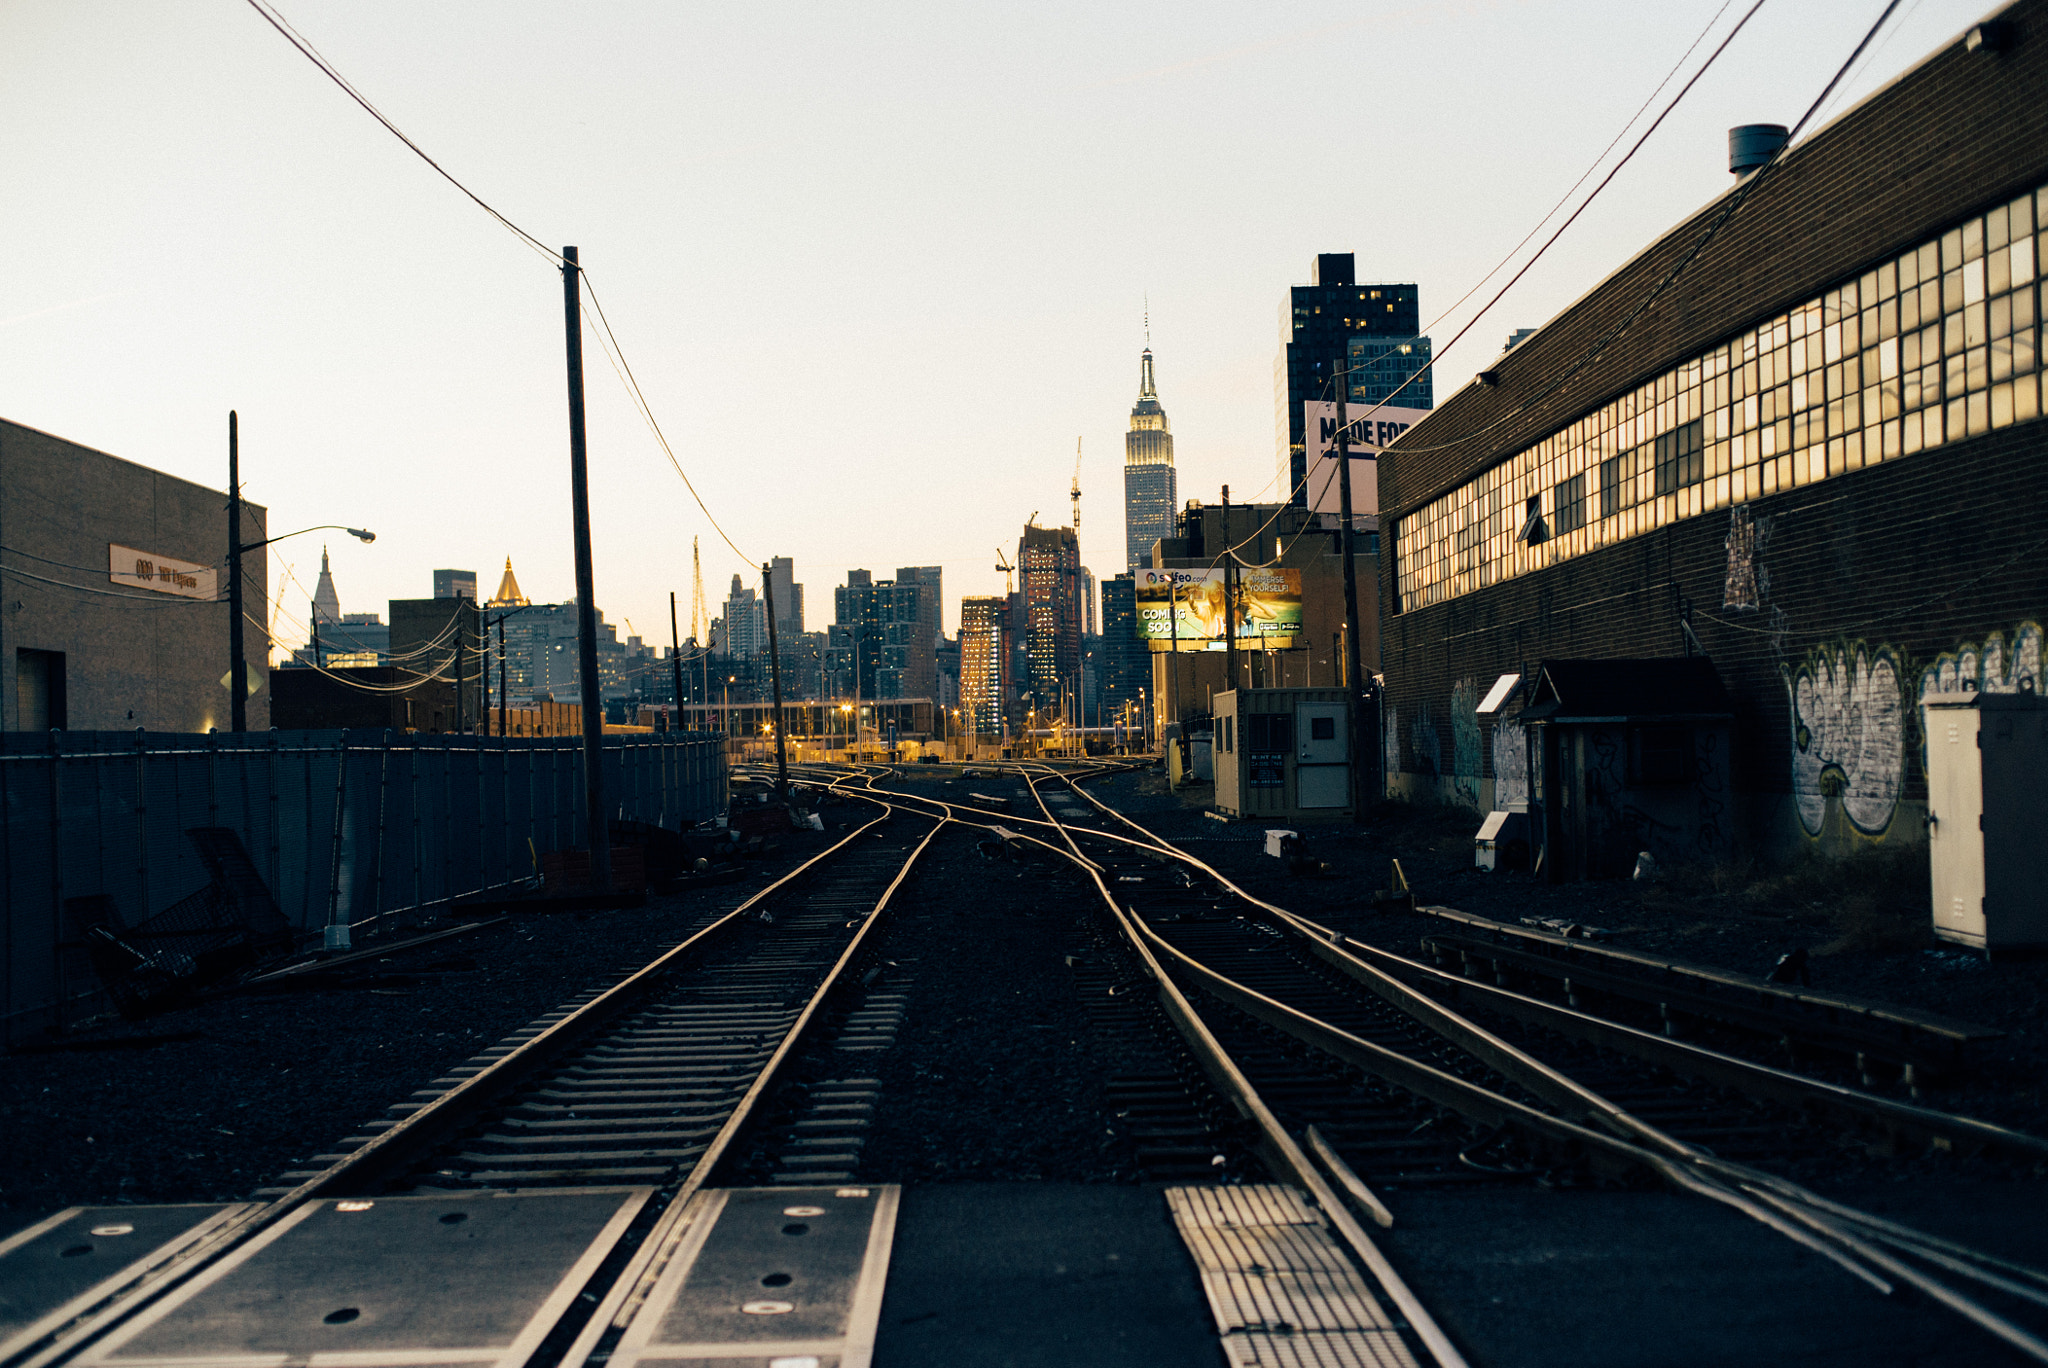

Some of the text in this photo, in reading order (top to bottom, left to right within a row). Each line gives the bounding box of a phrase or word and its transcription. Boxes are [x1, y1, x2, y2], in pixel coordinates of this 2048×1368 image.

[1320, 417, 1374, 445] MDE
[1159, 572, 1208, 583] slfeo.com
[1252, 575, 1285, 584] IMMERSE
[1250, 584, 1289, 593] YOURSELF!
